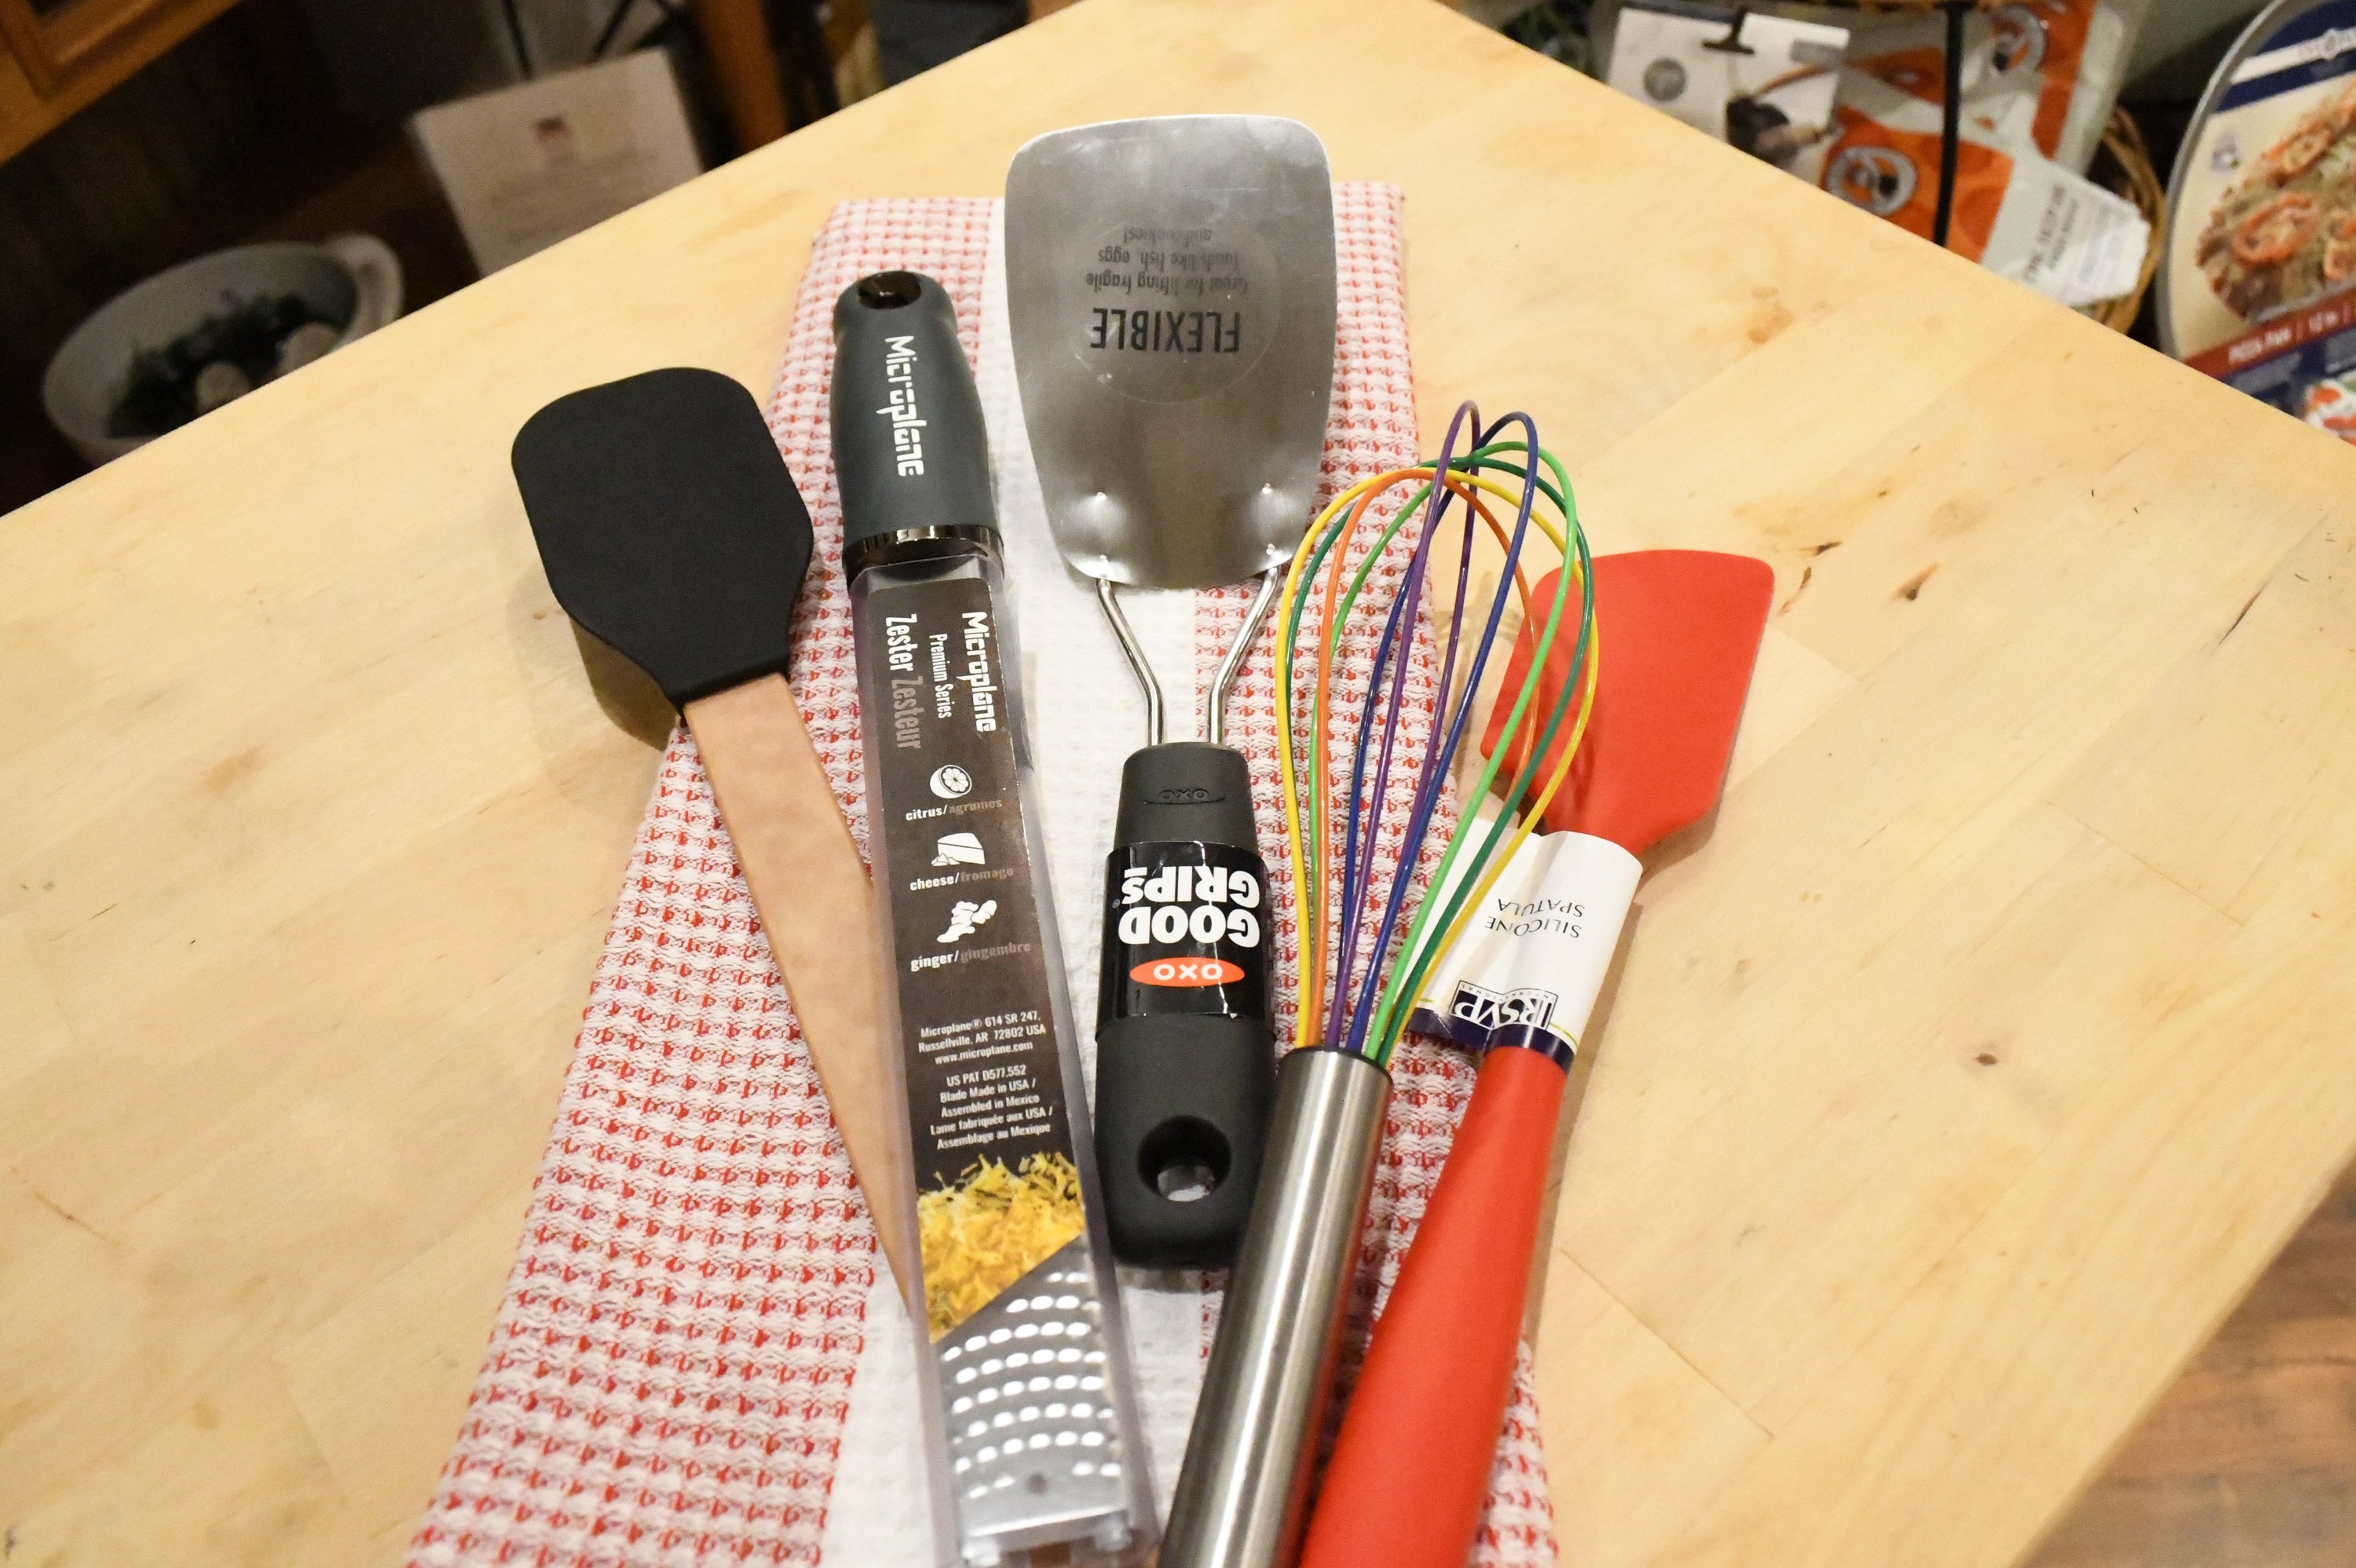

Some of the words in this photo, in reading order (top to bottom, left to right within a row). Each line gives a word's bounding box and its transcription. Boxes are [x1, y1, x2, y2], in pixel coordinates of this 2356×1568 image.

[1097, 246, 1131, 264] eggs
[1170, 252, 1197, 272] like
[1085, 269, 1133, 294] fragile
[1090, 307, 1241, 353] FLEXIBLE
[876, 335, 927, 477] Microplane
[884, 612, 918, 672] Zester
[928, 631, 949, 682] Premium
[957, 611, 997, 734] Microplane
[891, 675, 924, 751] Zesteur
[934, 682, 953, 720] Series
[1158, 788, 1209, 799] OXO
[1498, 898, 1585, 918] SPATULA
[1118, 905, 1260, 948] GOOD
[1484, 916, 1582, 938] SILICONE
[1153, 963, 1224, 981] OXO
[985, 1015, 1003, 1028] 614
[1005, 1013, 1018, 1025] SR
[1454, 994, 1549, 1029] RSVP
[975, 1032, 989, 1044] AR
[993, 1026, 1024, 1040] 72802
[1026, 1023, 1046, 1036] USA
[935, 1041, 1033, 1065] www.microplane.com
[939, 1089, 968, 1103] Blade
[969, 1085, 995, 1099] Made
[997, 1084, 1008, 1094] in
[1008, 1079, 1030, 1091] USA
[946, 1074, 961, 1087] US
[963, 1071, 980, 1084] PAT
[941, 1101, 993, 1118] Assembled
[994, 1098, 1004, 1109] in
[1006, 1094, 1040, 1108] Mexico
[930, 1122, 957, 1136] Lame
[958, 1113, 1004, 1131] fabriquée
[1006, 1112, 1023, 1123] aux
[1025, 1106, 1046, 1119] USA
[937, 1131, 994, 1150] Assemblage
[996, 1128, 1009, 1139] au
[1011, 1122, 1052, 1139] Mexique
